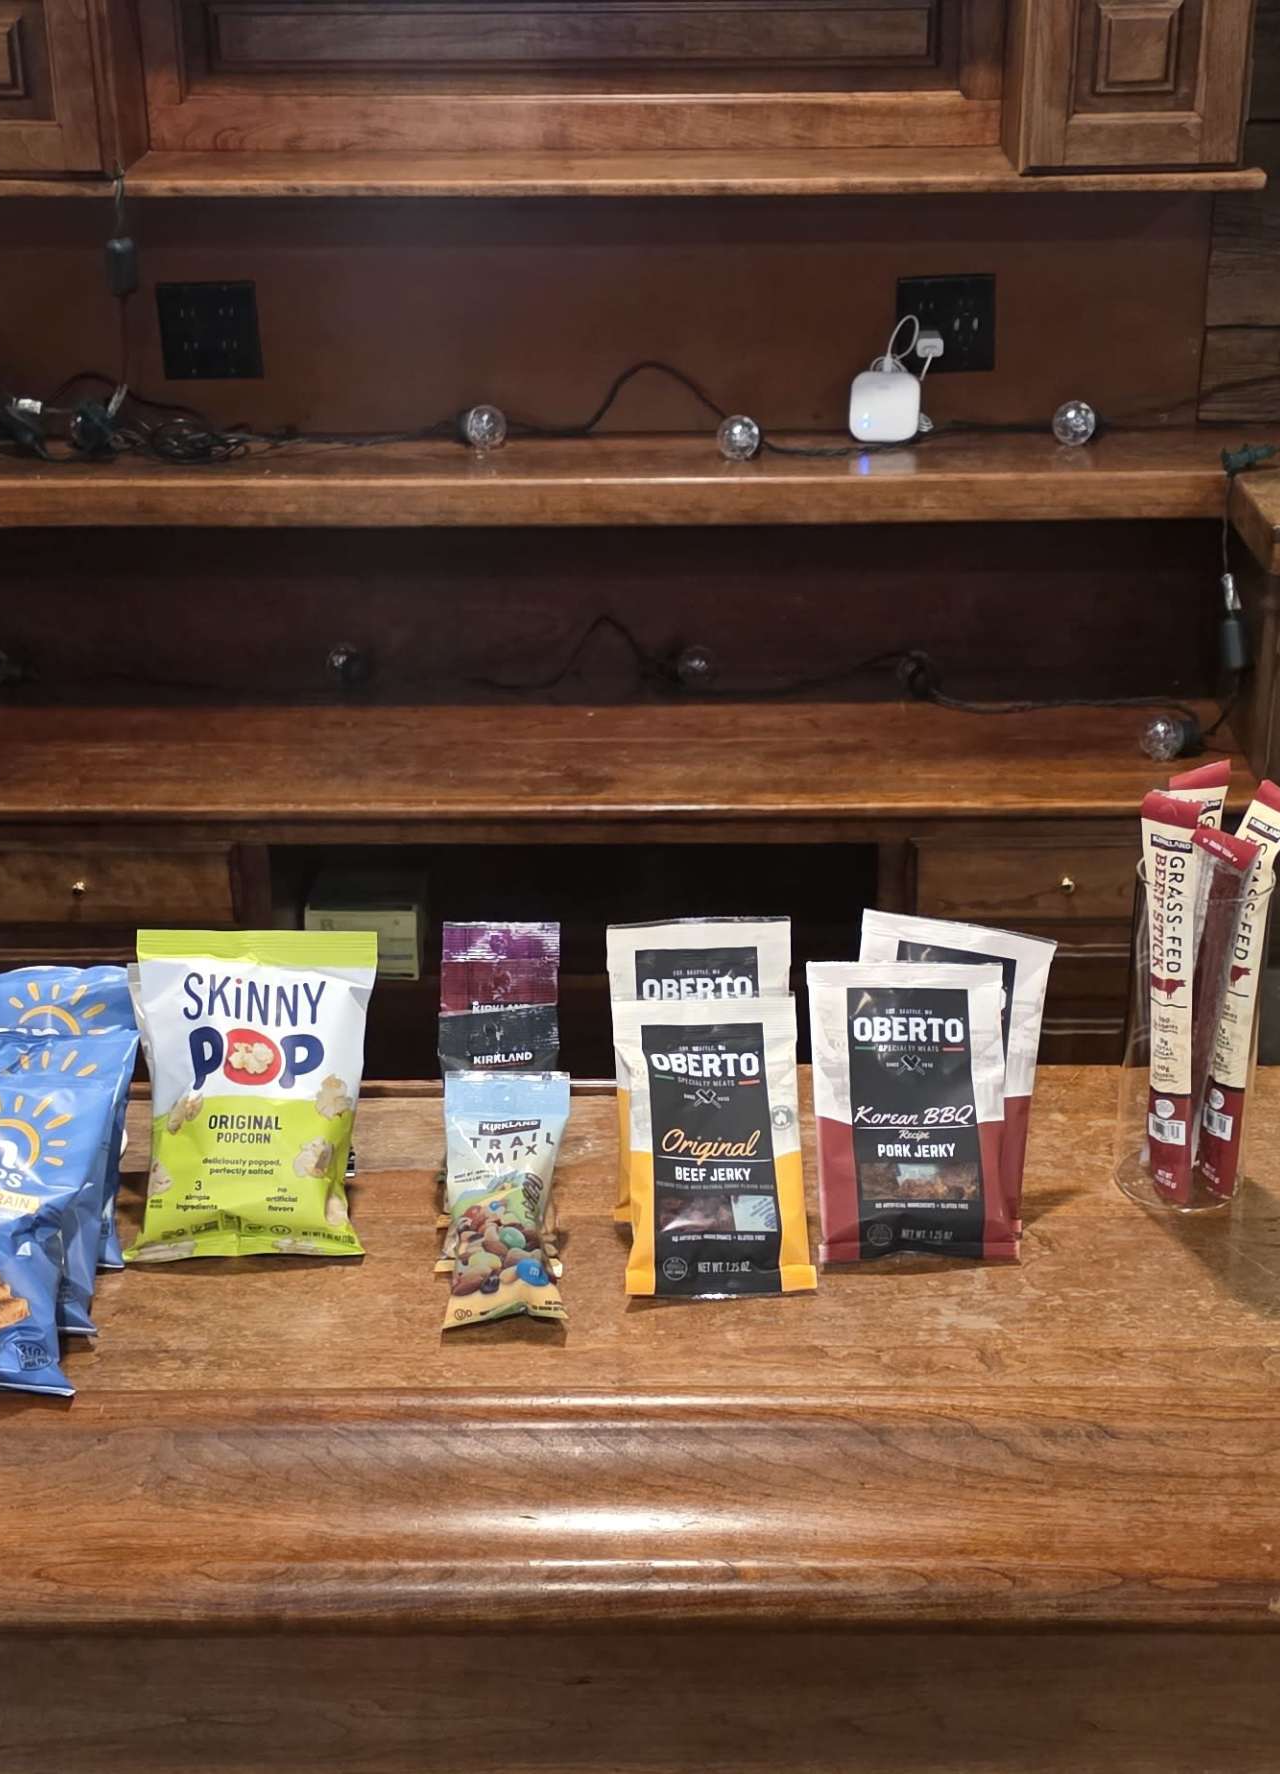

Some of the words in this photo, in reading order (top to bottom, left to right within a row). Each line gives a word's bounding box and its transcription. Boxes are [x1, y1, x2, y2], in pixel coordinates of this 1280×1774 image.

[1166, 856, 1185, 973] GRASS-FED
[1152, 909, 1164, 971] STICK
[642, 976, 753, 1000] OBERTO
[853, 1016, 964, 1043] OBERTO
[189, 1026, 325, 1090] POP
[473, 1051, 533, 1065] KIRKLAND
[650, 1052, 760, 1078] OBERTO
[208, 1114, 282, 1131] ORIGINAL
[854, 1105, 918, 1126] Korean
[923, 1104, 974, 1125] BBQ
[482, 1119, 538, 1131] KIRKLAND
[217, 1132, 271, 1144] POPCORN
[470, 1132, 555, 1149] TRAIL
[486, 1143, 537, 1164] MIX
[661, 1128, 761, 1166] Original
[877, 1143, 912, 1158] PORK
[914, 1142, 956, 1158] JERKY
[202, 1157, 247, 1167] deliciously
[209, 1167, 247, 1177] perfectly
[248, 1167, 274, 1175] salted
[675, 1166, 706, 1182] BEEF
[709, 1167, 751, 1182] JERKY
[194, 1180, 202, 1190] 3
[176, 1203, 218, 1212] ingredients
